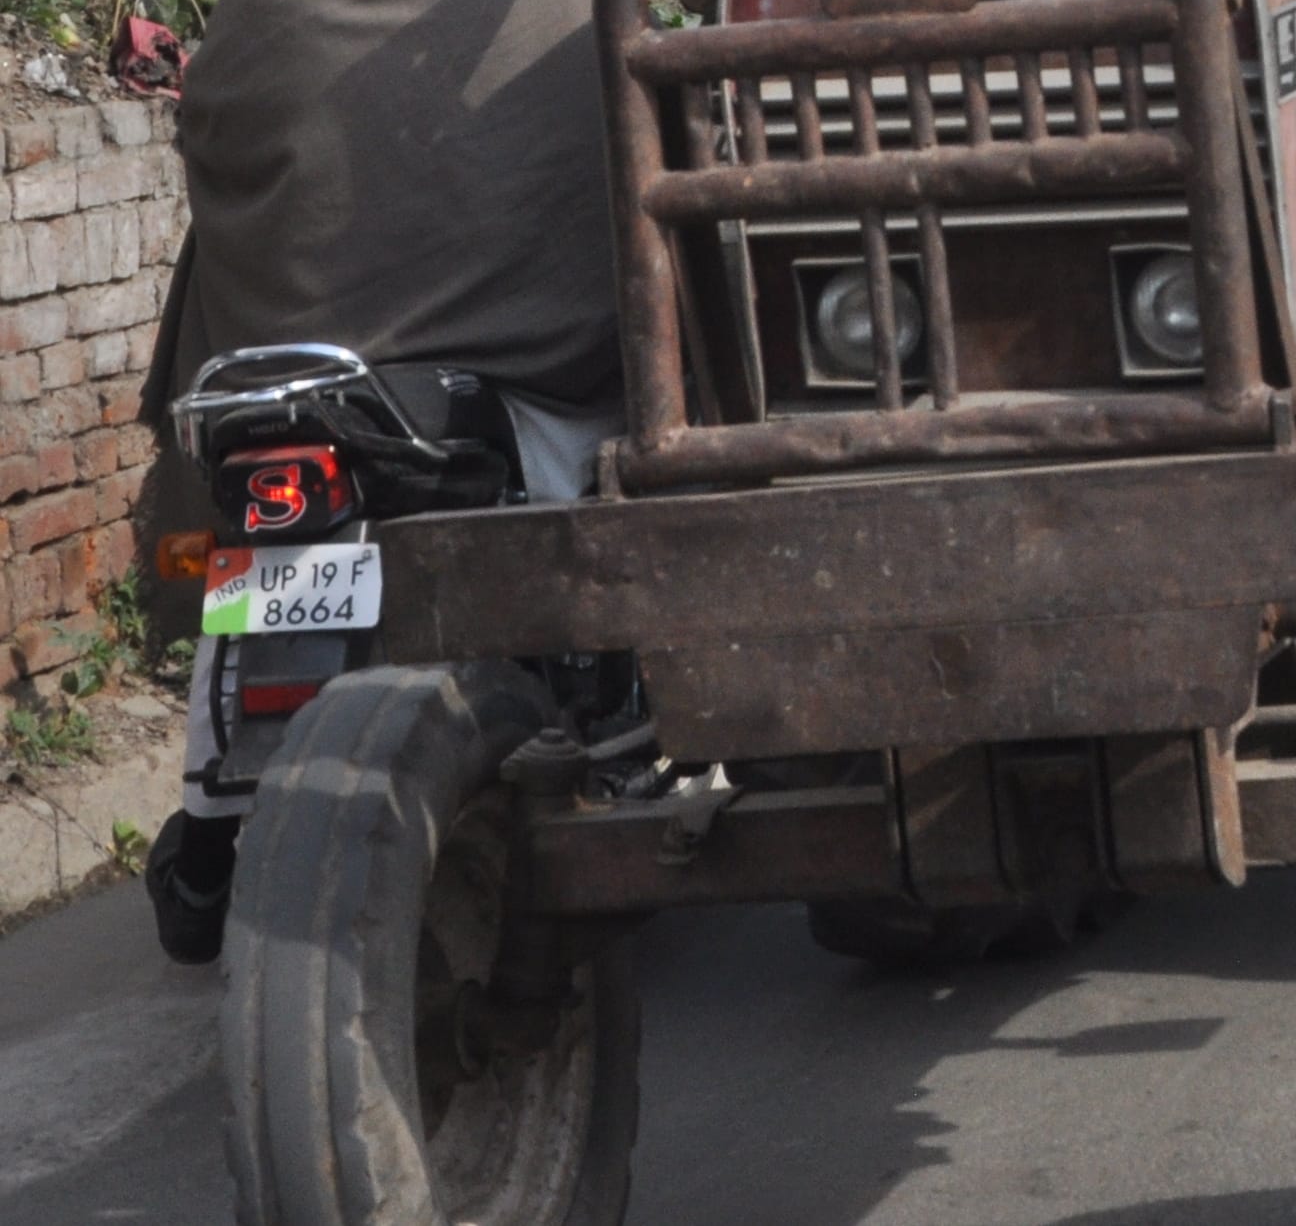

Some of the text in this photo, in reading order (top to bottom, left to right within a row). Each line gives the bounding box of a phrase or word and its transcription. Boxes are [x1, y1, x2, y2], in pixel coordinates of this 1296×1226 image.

[243, 463, 308, 533] S
[214, 577, 248, 603] IND
[260, 559, 367, 592] UP 19 F
[263, 595, 355, 626] 8664
